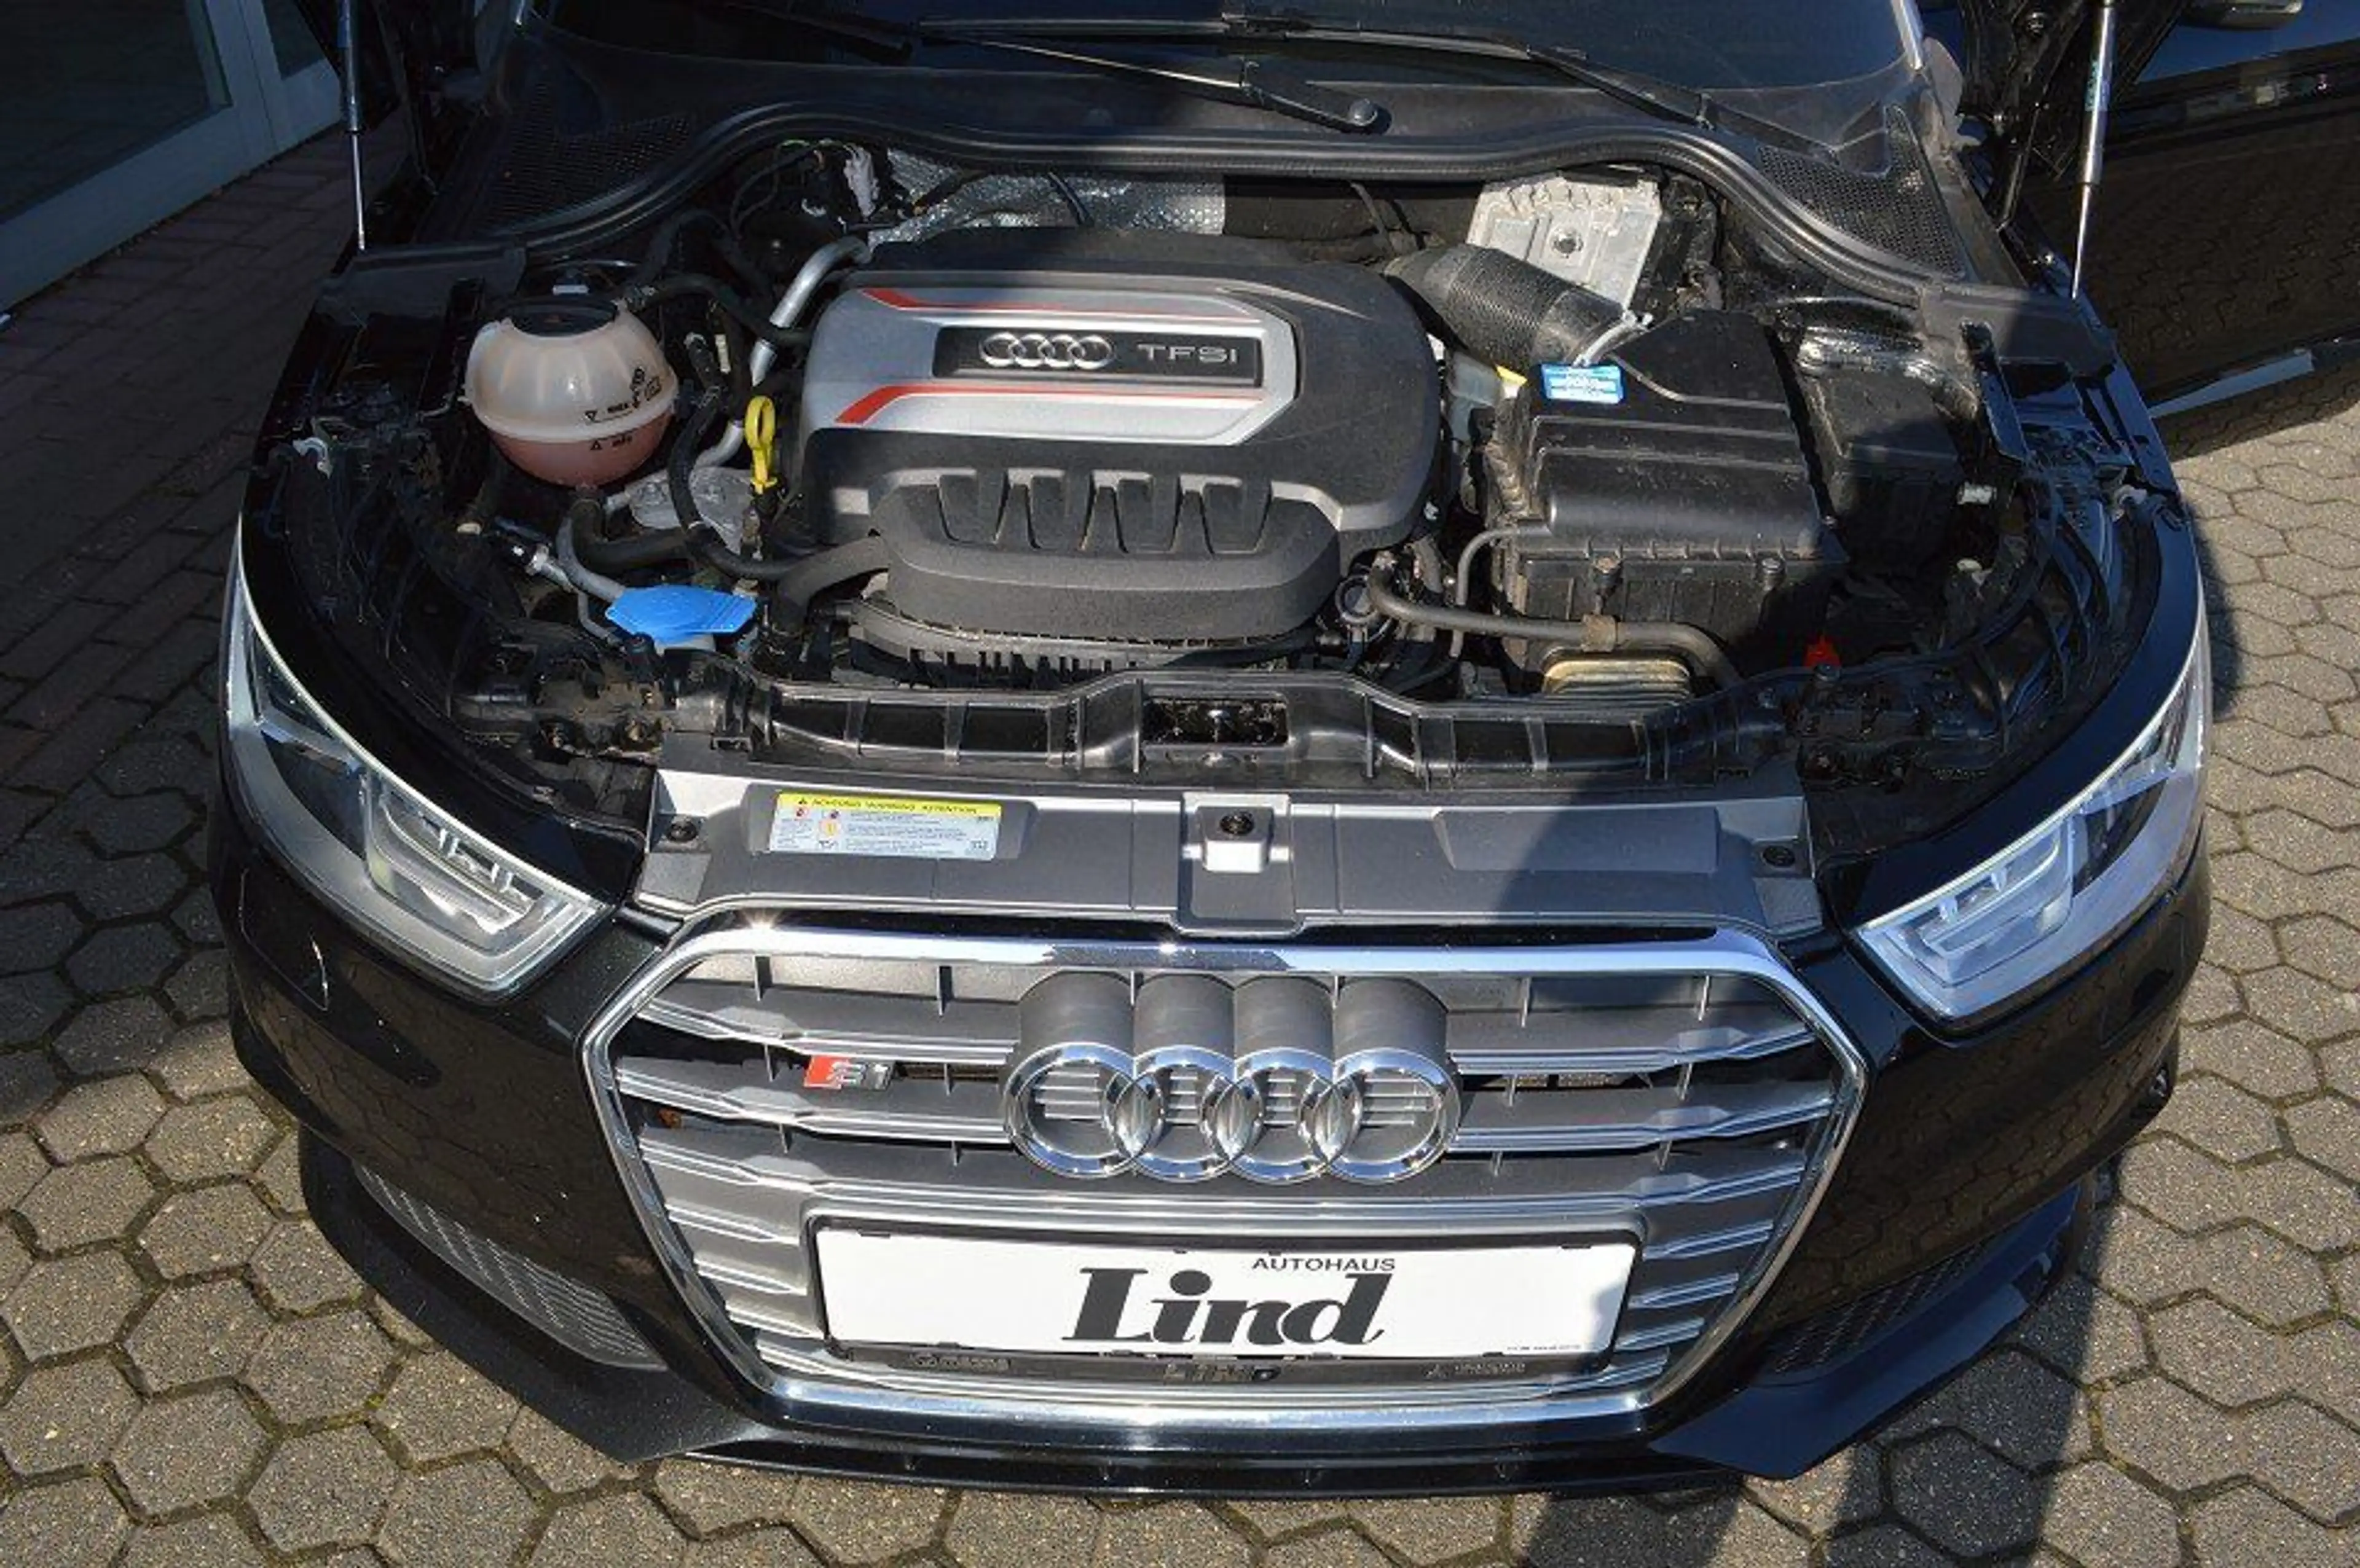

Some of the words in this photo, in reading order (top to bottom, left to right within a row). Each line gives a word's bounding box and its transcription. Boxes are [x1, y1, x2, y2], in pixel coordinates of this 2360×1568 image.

[1138, 344, 1238, 364] TFSI
[1252, 1257, 1396, 1271] AUTOHAUS
[1061, 1267, 1393, 1346] Lind
